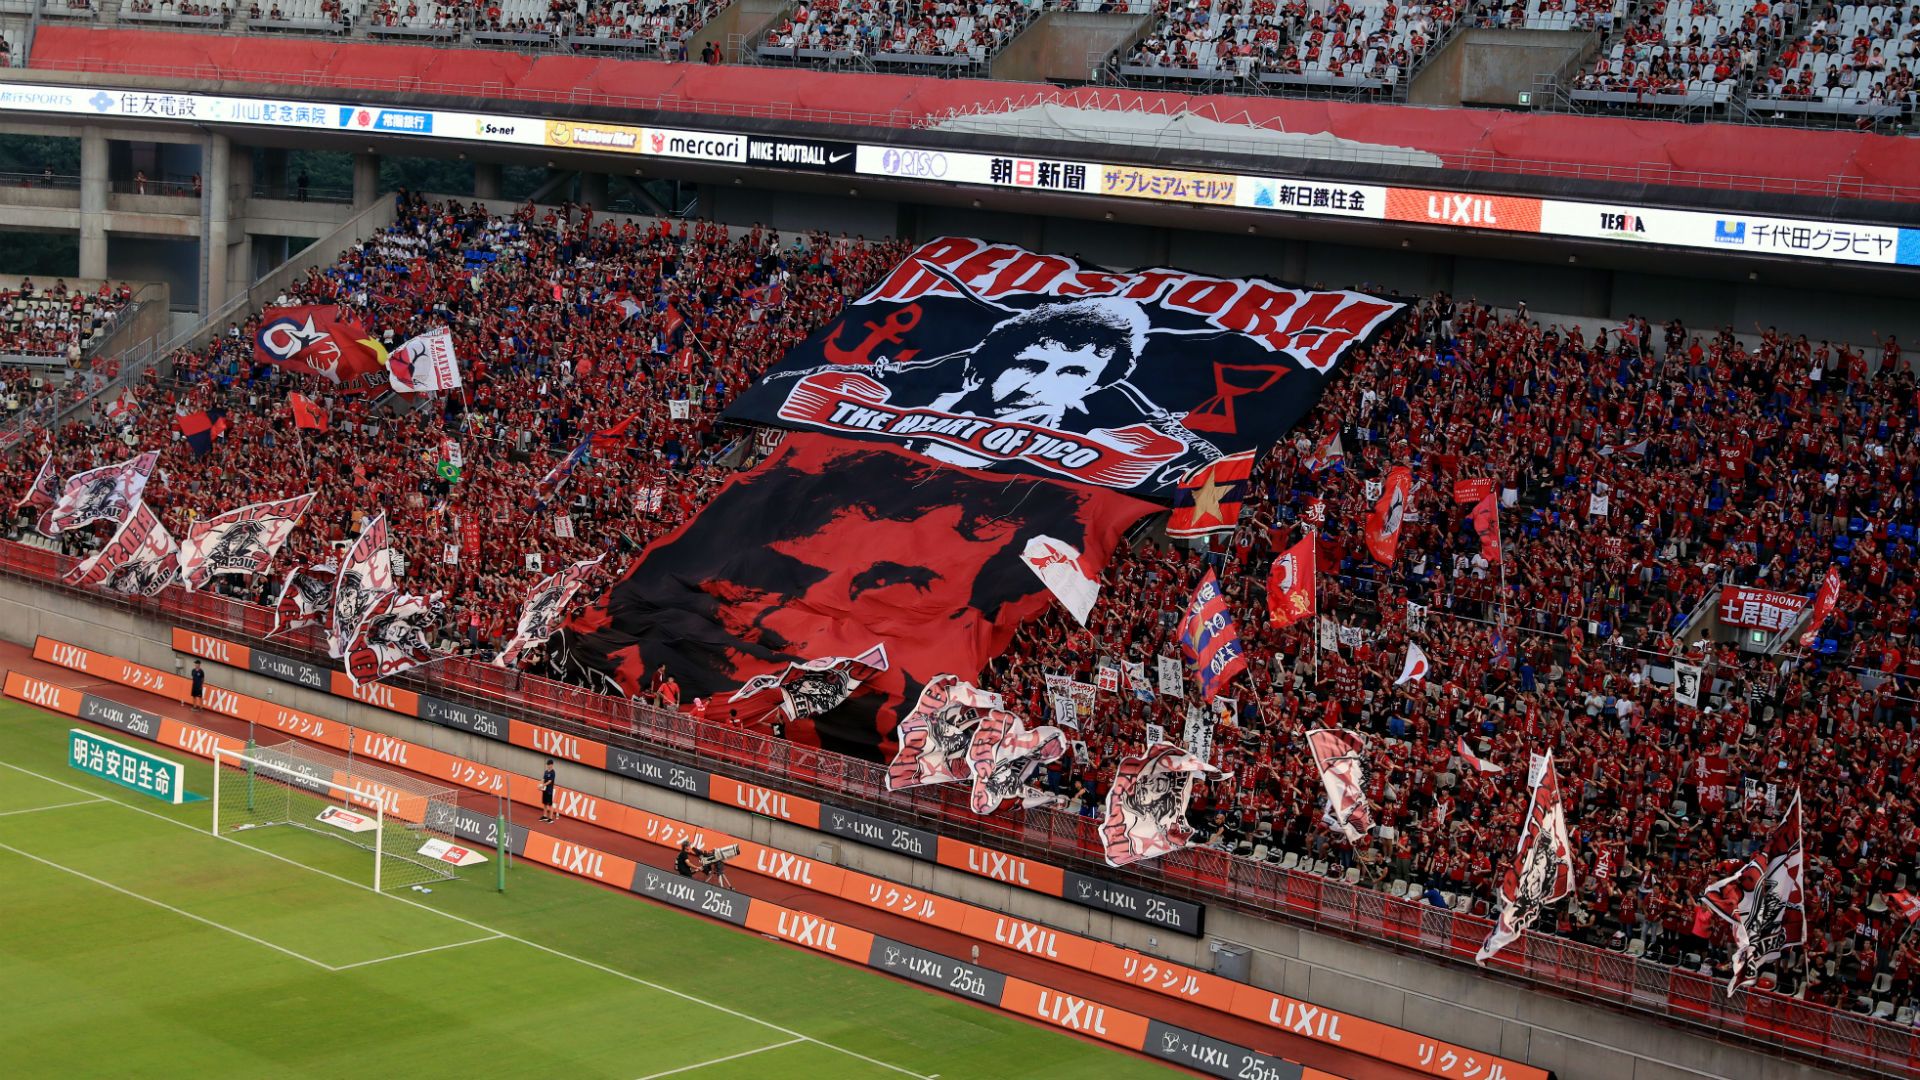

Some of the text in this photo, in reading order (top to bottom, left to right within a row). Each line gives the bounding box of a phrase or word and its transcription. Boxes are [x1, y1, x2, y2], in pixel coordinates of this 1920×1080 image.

[121, 93, 197, 117] 住友電設
[231, 102, 326, 125] 小山記念病院
[485, 123, 515, 136] So-net
[670, 136, 740, 158] mercari
[750, 141, 826, 165] NIKE FOOTBALL
[990, 158, 1086, 190] 朝日新聞
[1104, 170, 1234, 200] ザ・プレミアム・モルツ
[1428, 195, 1497, 224] LIXIL
[1751, 224, 1893, 257] 千代田グラビヤ
[828, 401, 898, 432] THE
[889, 413, 994, 441] HEART
[981, 427, 1031, 456] OF
[1765, 594, 1802, 609] SHOMA
[52, 644, 87, 670] LIXIL
[191, 635, 230, 662] LIXIL
[122, 665, 165, 691] リクシル
[273, 661, 295, 676] LIXIL
[299, 666, 321, 687] 25th
[23, 679, 61, 708] LIXIL
[352, 683, 396, 708] LIXIL
[103, 708, 124, 724] LIXIL
[127, 712, 150, 735] 25th
[277, 711, 324, 738] リクシル
[444, 708, 468, 724] LIXIL
[473, 713, 498, 736] 25th
[179, 727, 220, 757] LIXIL
[364, 734, 408, 764] LIXIL
[533, 728, 581, 760] LIXIL
[74, 737, 171, 796] 明治安田生命
[451, 761, 504, 791] リクシル
[636, 761, 663, 779] LIXIL
[669, 768, 697, 792] 25th
[552, 789, 597, 820] LIXIL
[737, 785, 790, 818] LIXIL
[455, 818, 481, 834] LIXIL
[646, 819, 706, 850] リクシル
[854, 822, 884, 840] LIXIL
[891, 829, 922, 854] 25th
[552, 842, 603, 878] LIXIL
[757, 848, 812, 884] LIXIL
[969, 848, 1030, 885] LIXIL
[667, 881, 696, 902] LIXIL
[702, 890, 733, 917] 25th
[869, 883, 936, 918] リクシル
[1103, 889, 1137, 911] LIXIL
[1145, 898, 1181, 927] 25th
[778, 911, 837, 951] LIXIL
[995, 918, 1058, 958] LIXIL
[910, 957, 943, 978] LIXIL
[950, 966, 985, 997] 25th
[1123, 957, 1200, 996] リクシル
[1037, 991, 1107, 1035] LIXIL
[1269, 998, 1342, 1042] LIXIL
[1191, 1043, 1229, 1068] LIXIL
[1238, 1056, 1280, 1080] 25th
[1418, 1043, 1507, 1080] リクシル
